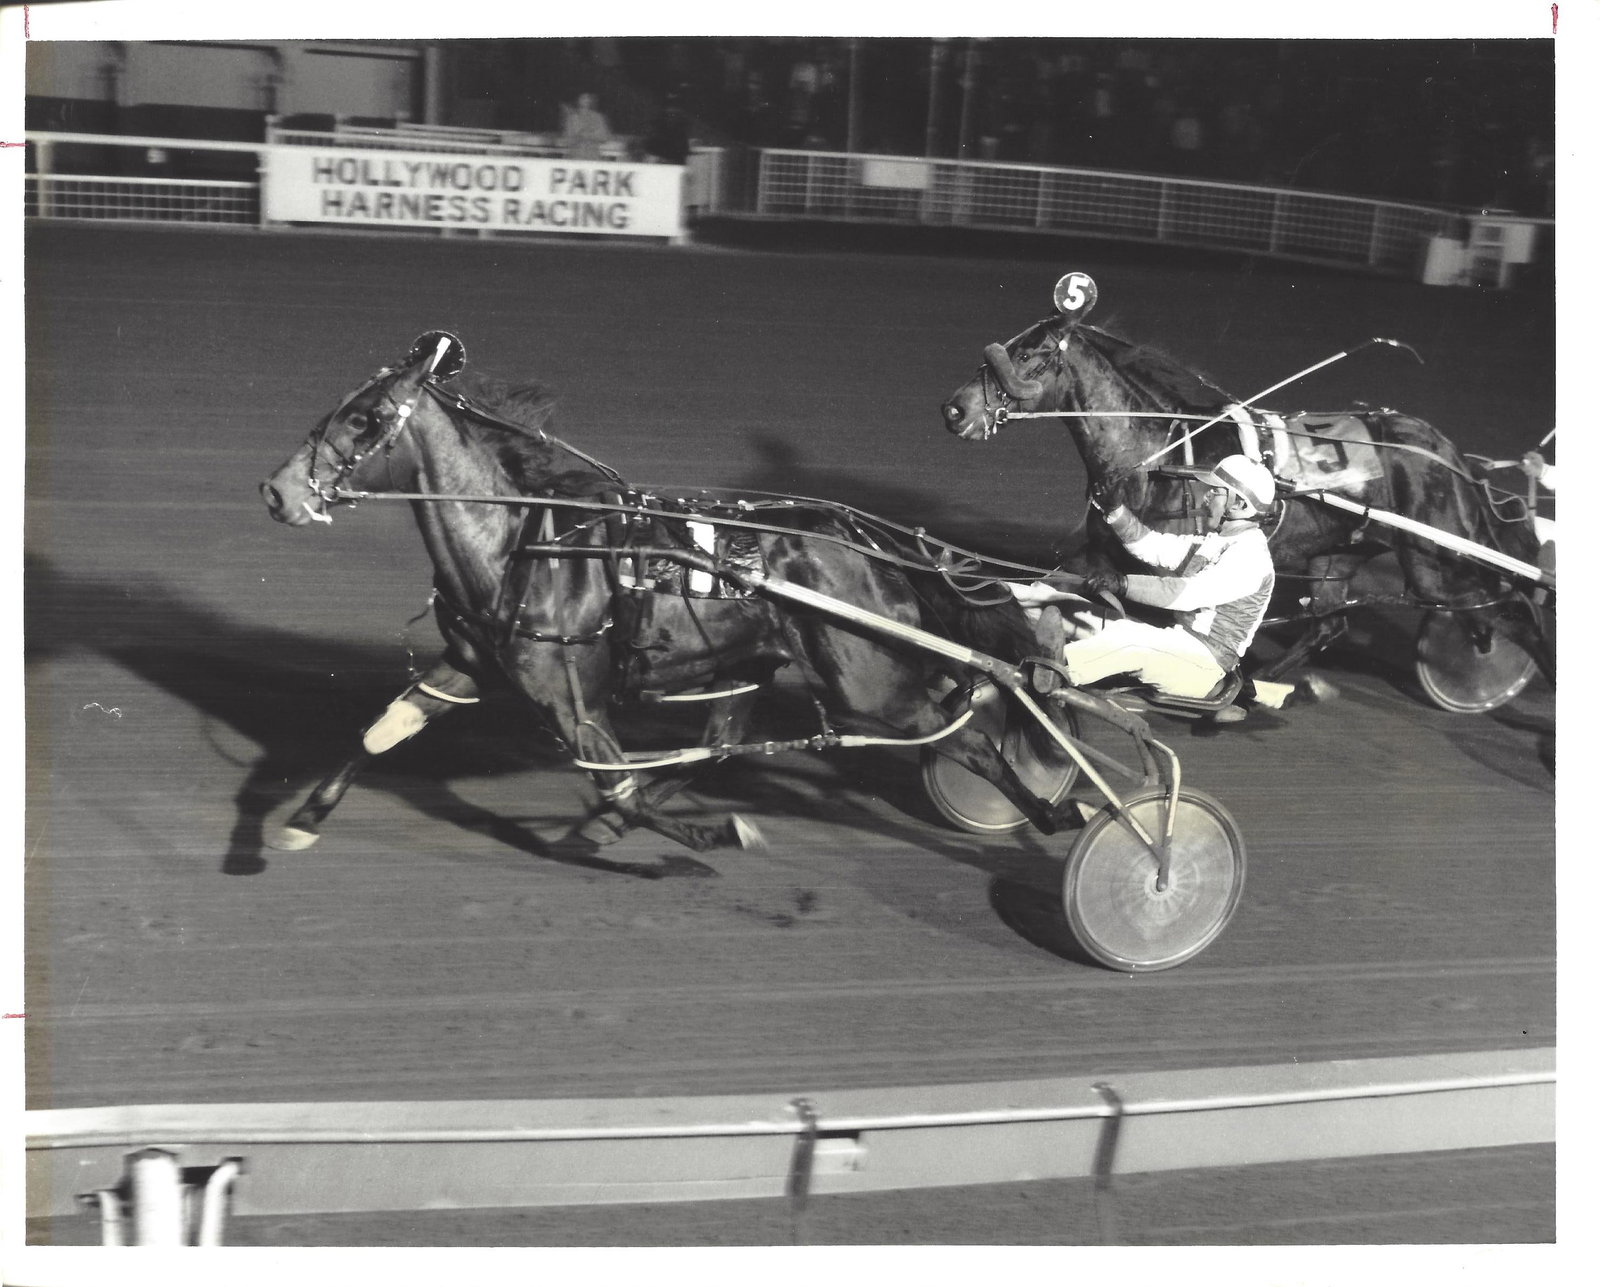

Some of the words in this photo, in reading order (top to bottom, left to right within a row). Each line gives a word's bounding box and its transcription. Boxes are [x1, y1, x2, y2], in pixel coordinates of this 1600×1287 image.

[313, 157, 522, 192] HOLLYWOOD
[551, 168, 636, 197] PARK
[322, 189, 489, 223] HARNESS
[503, 198, 628, 229] RACING
[1063, 275, 1090, 310] 5
[1304, 423, 1349, 474] 5
